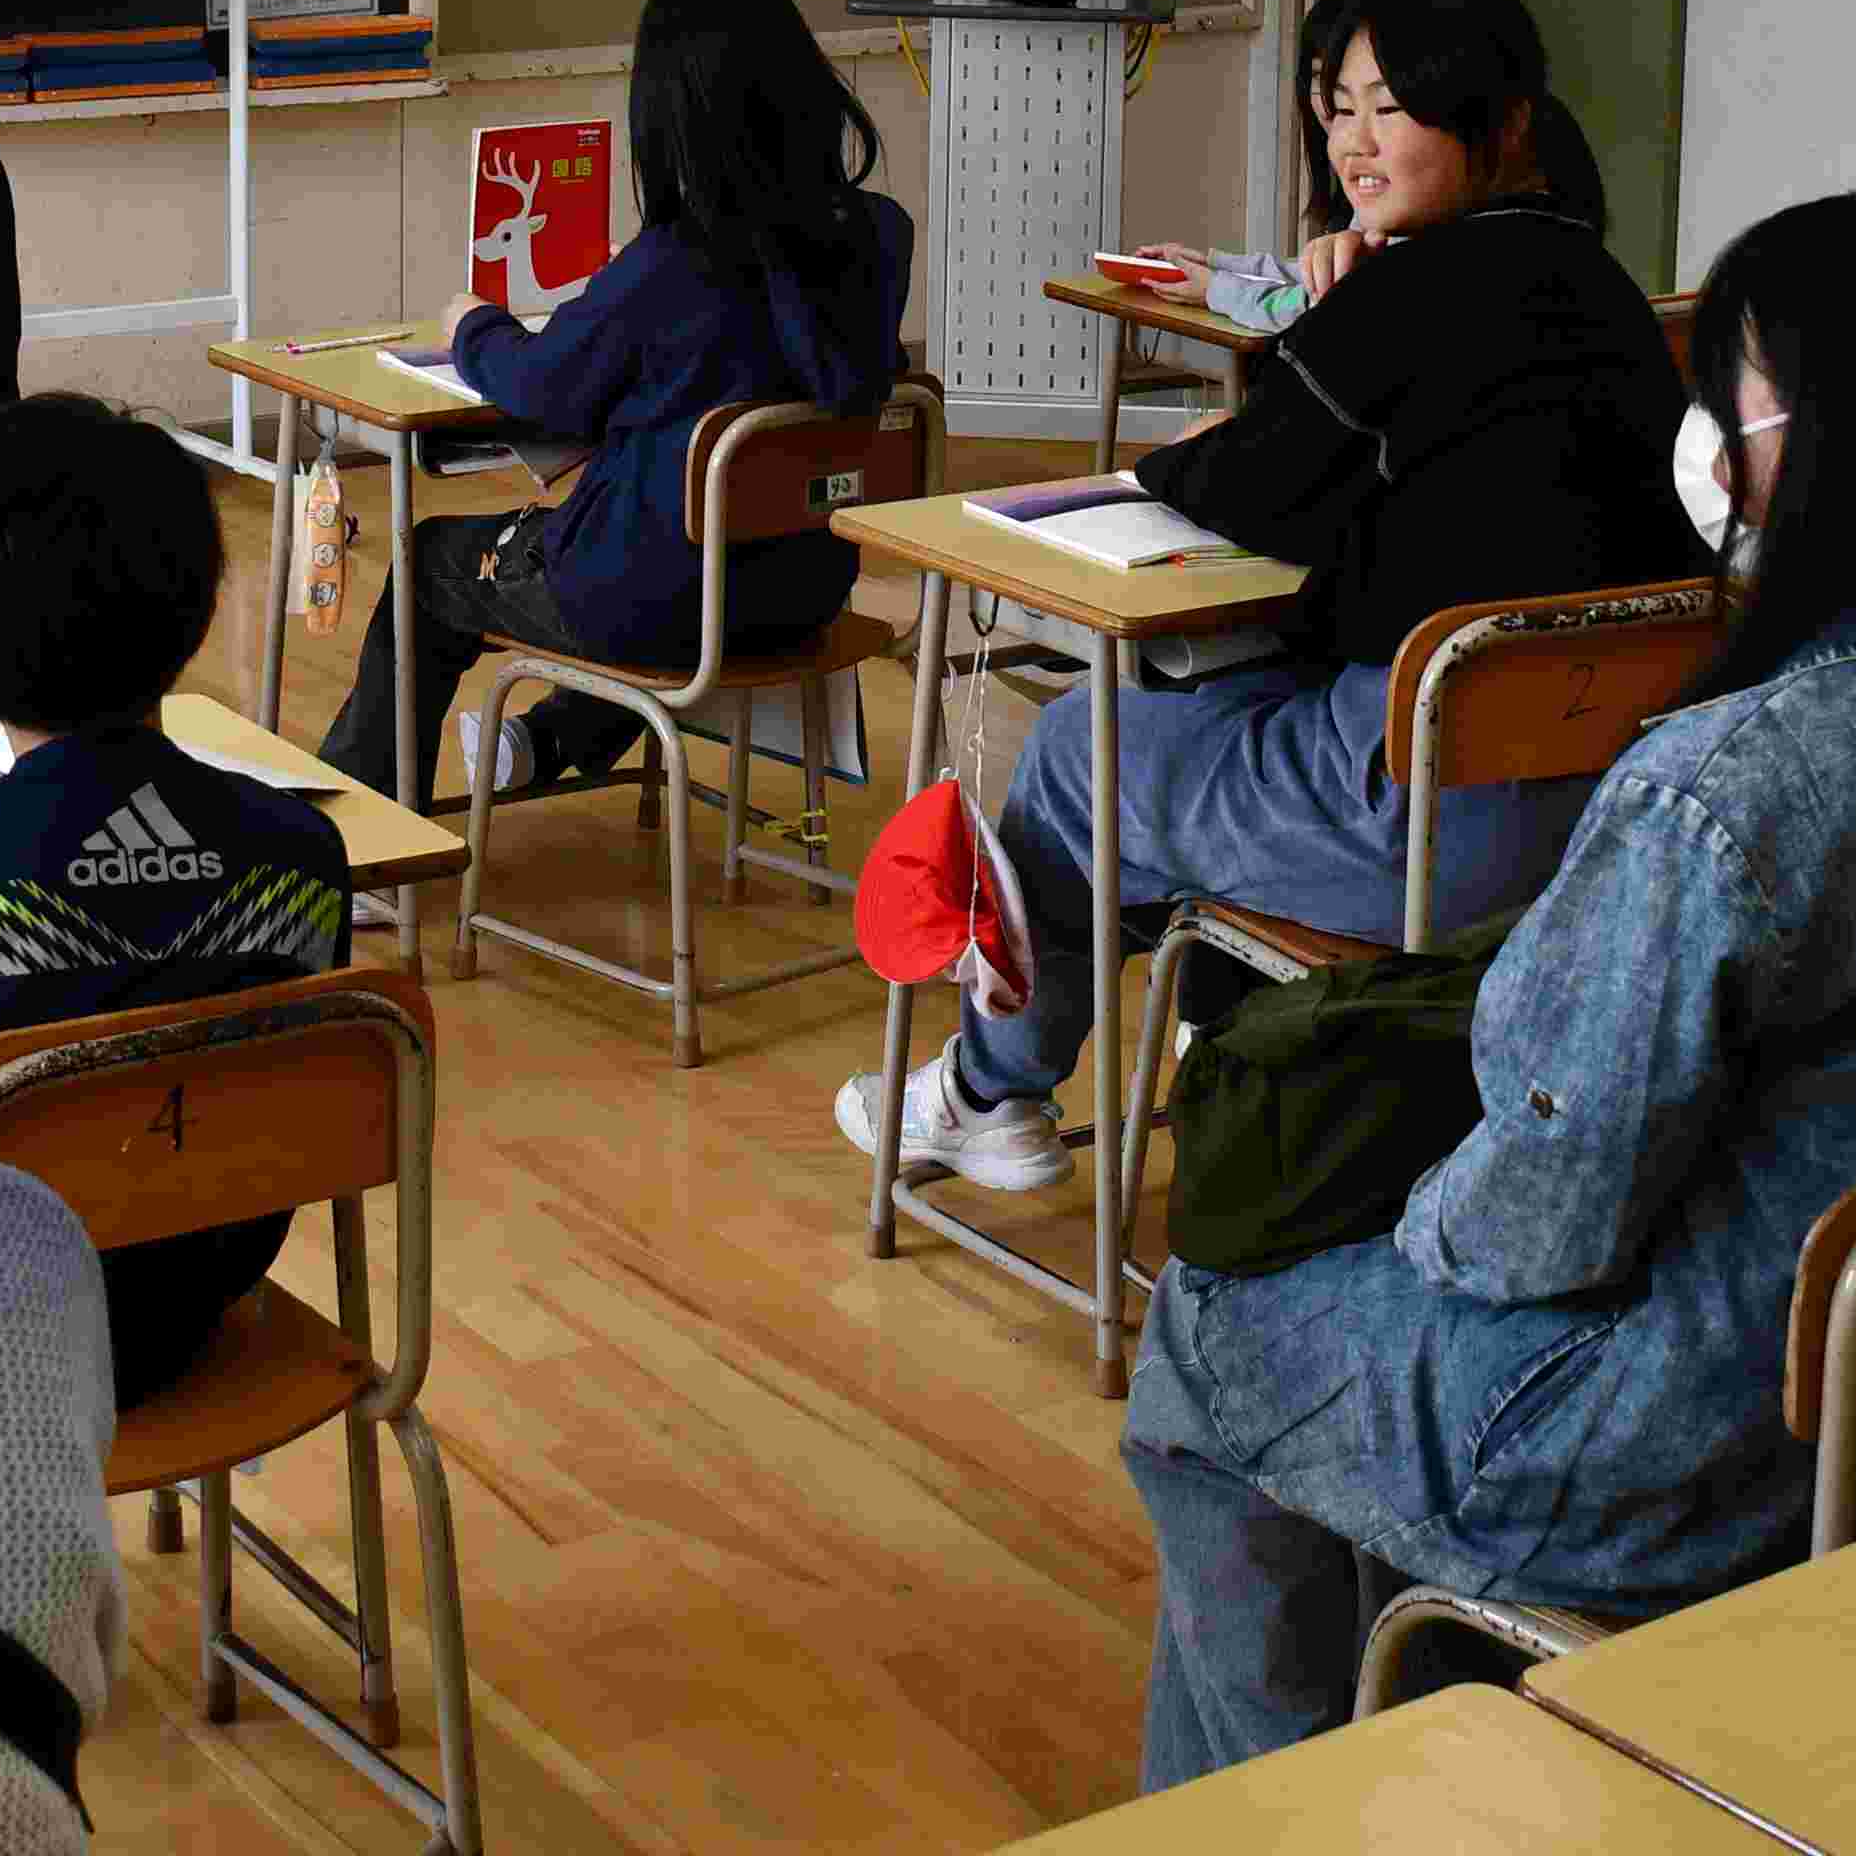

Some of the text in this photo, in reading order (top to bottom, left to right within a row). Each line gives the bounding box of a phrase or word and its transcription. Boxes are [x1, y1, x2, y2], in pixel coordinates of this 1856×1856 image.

[1559, 662, 1604, 721] 2
[67, 847, 224, 889] adidas
[146, 1082, 197, 1153] 4
